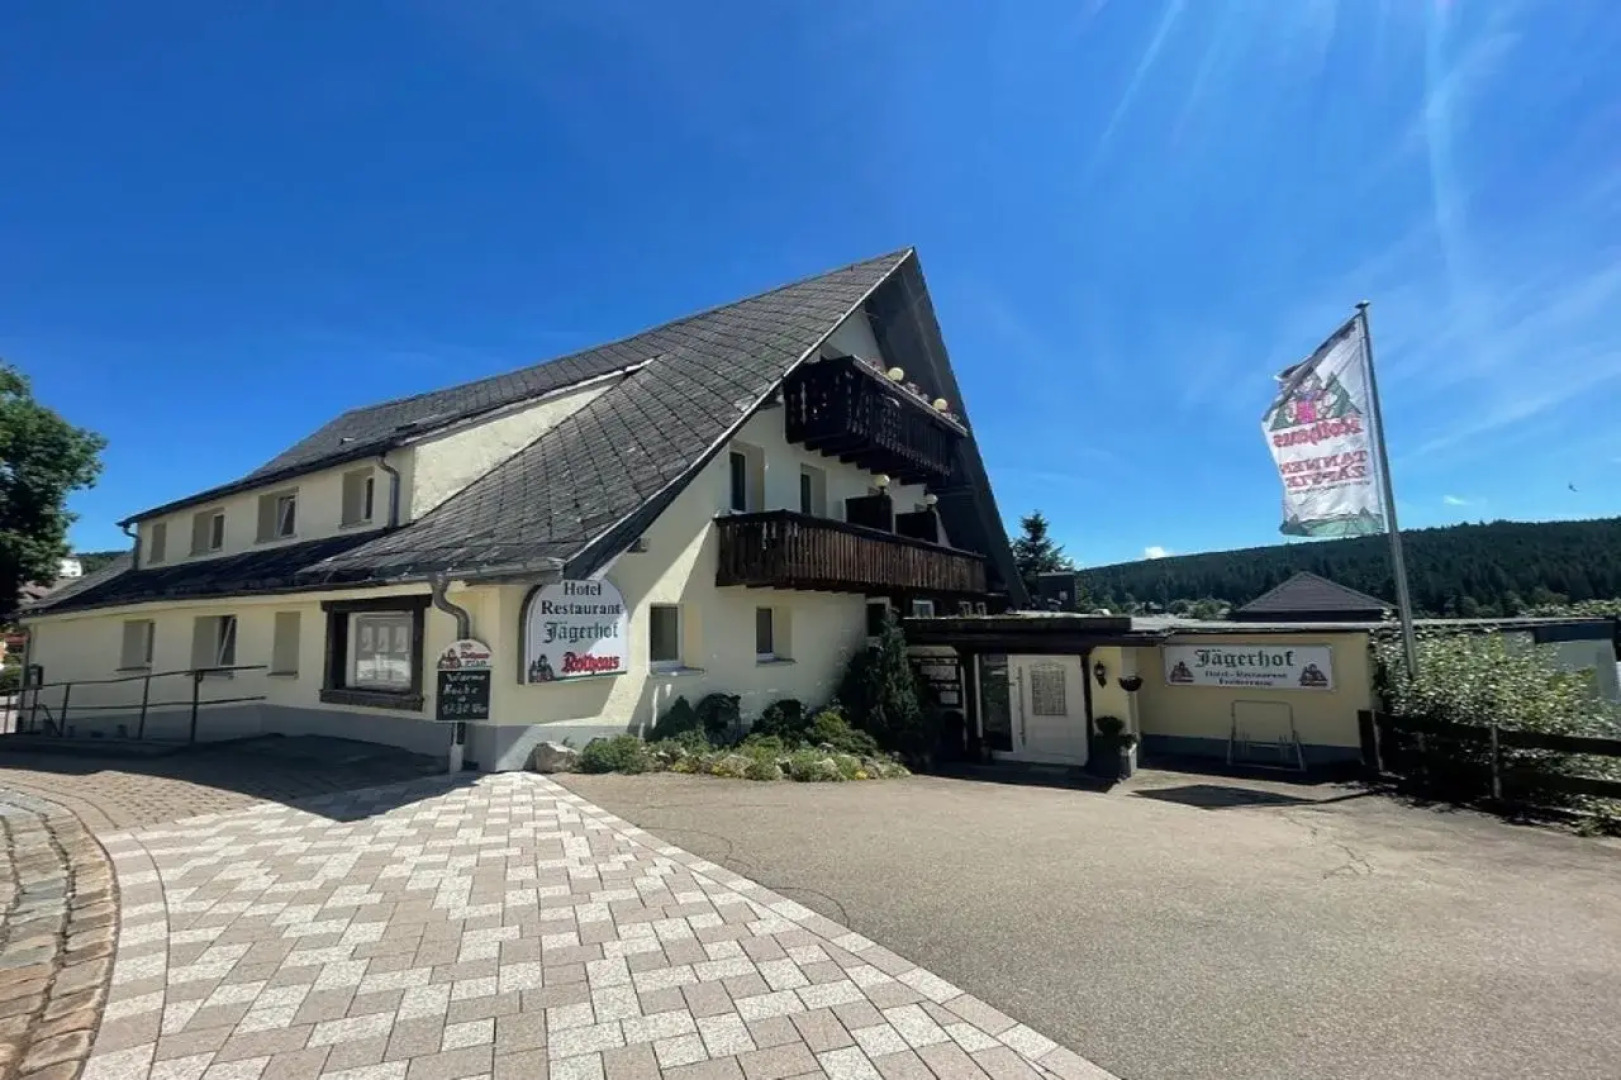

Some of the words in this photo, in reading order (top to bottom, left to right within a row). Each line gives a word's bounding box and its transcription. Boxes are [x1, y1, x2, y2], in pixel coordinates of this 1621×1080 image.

[564, 581, 602, 596] Hotel
[541, 600, 622, 615] Restaurant
[543, 621, 619, 644] Jägerhof
[561, 651, 620, 673] Rothaus
[1194, 649, 1295, 669] Jägerhof
